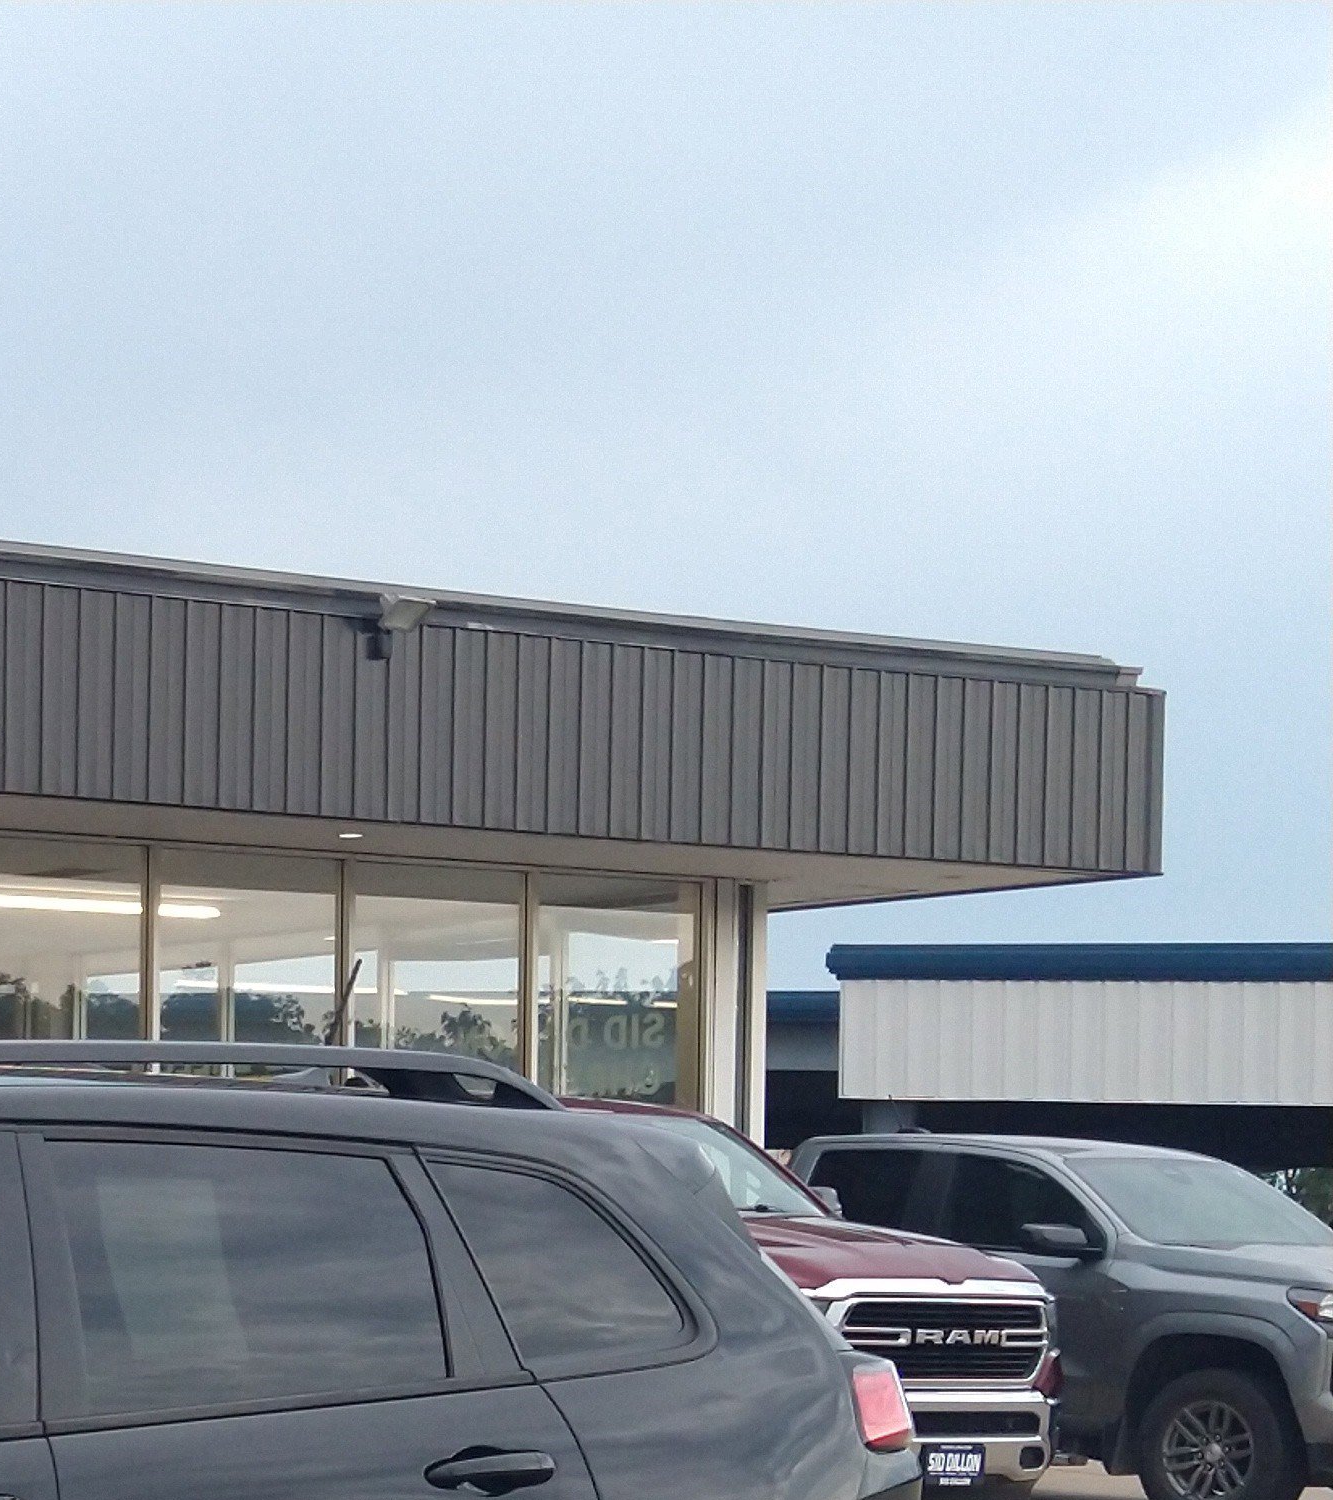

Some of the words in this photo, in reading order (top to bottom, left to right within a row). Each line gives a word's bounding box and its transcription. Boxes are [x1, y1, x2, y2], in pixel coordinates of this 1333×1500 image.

[915, 1329, 1000, 1345] RAM
[927, 1452, 945, 1472] SID
[945, 1452, 982, 1472] DILLON
